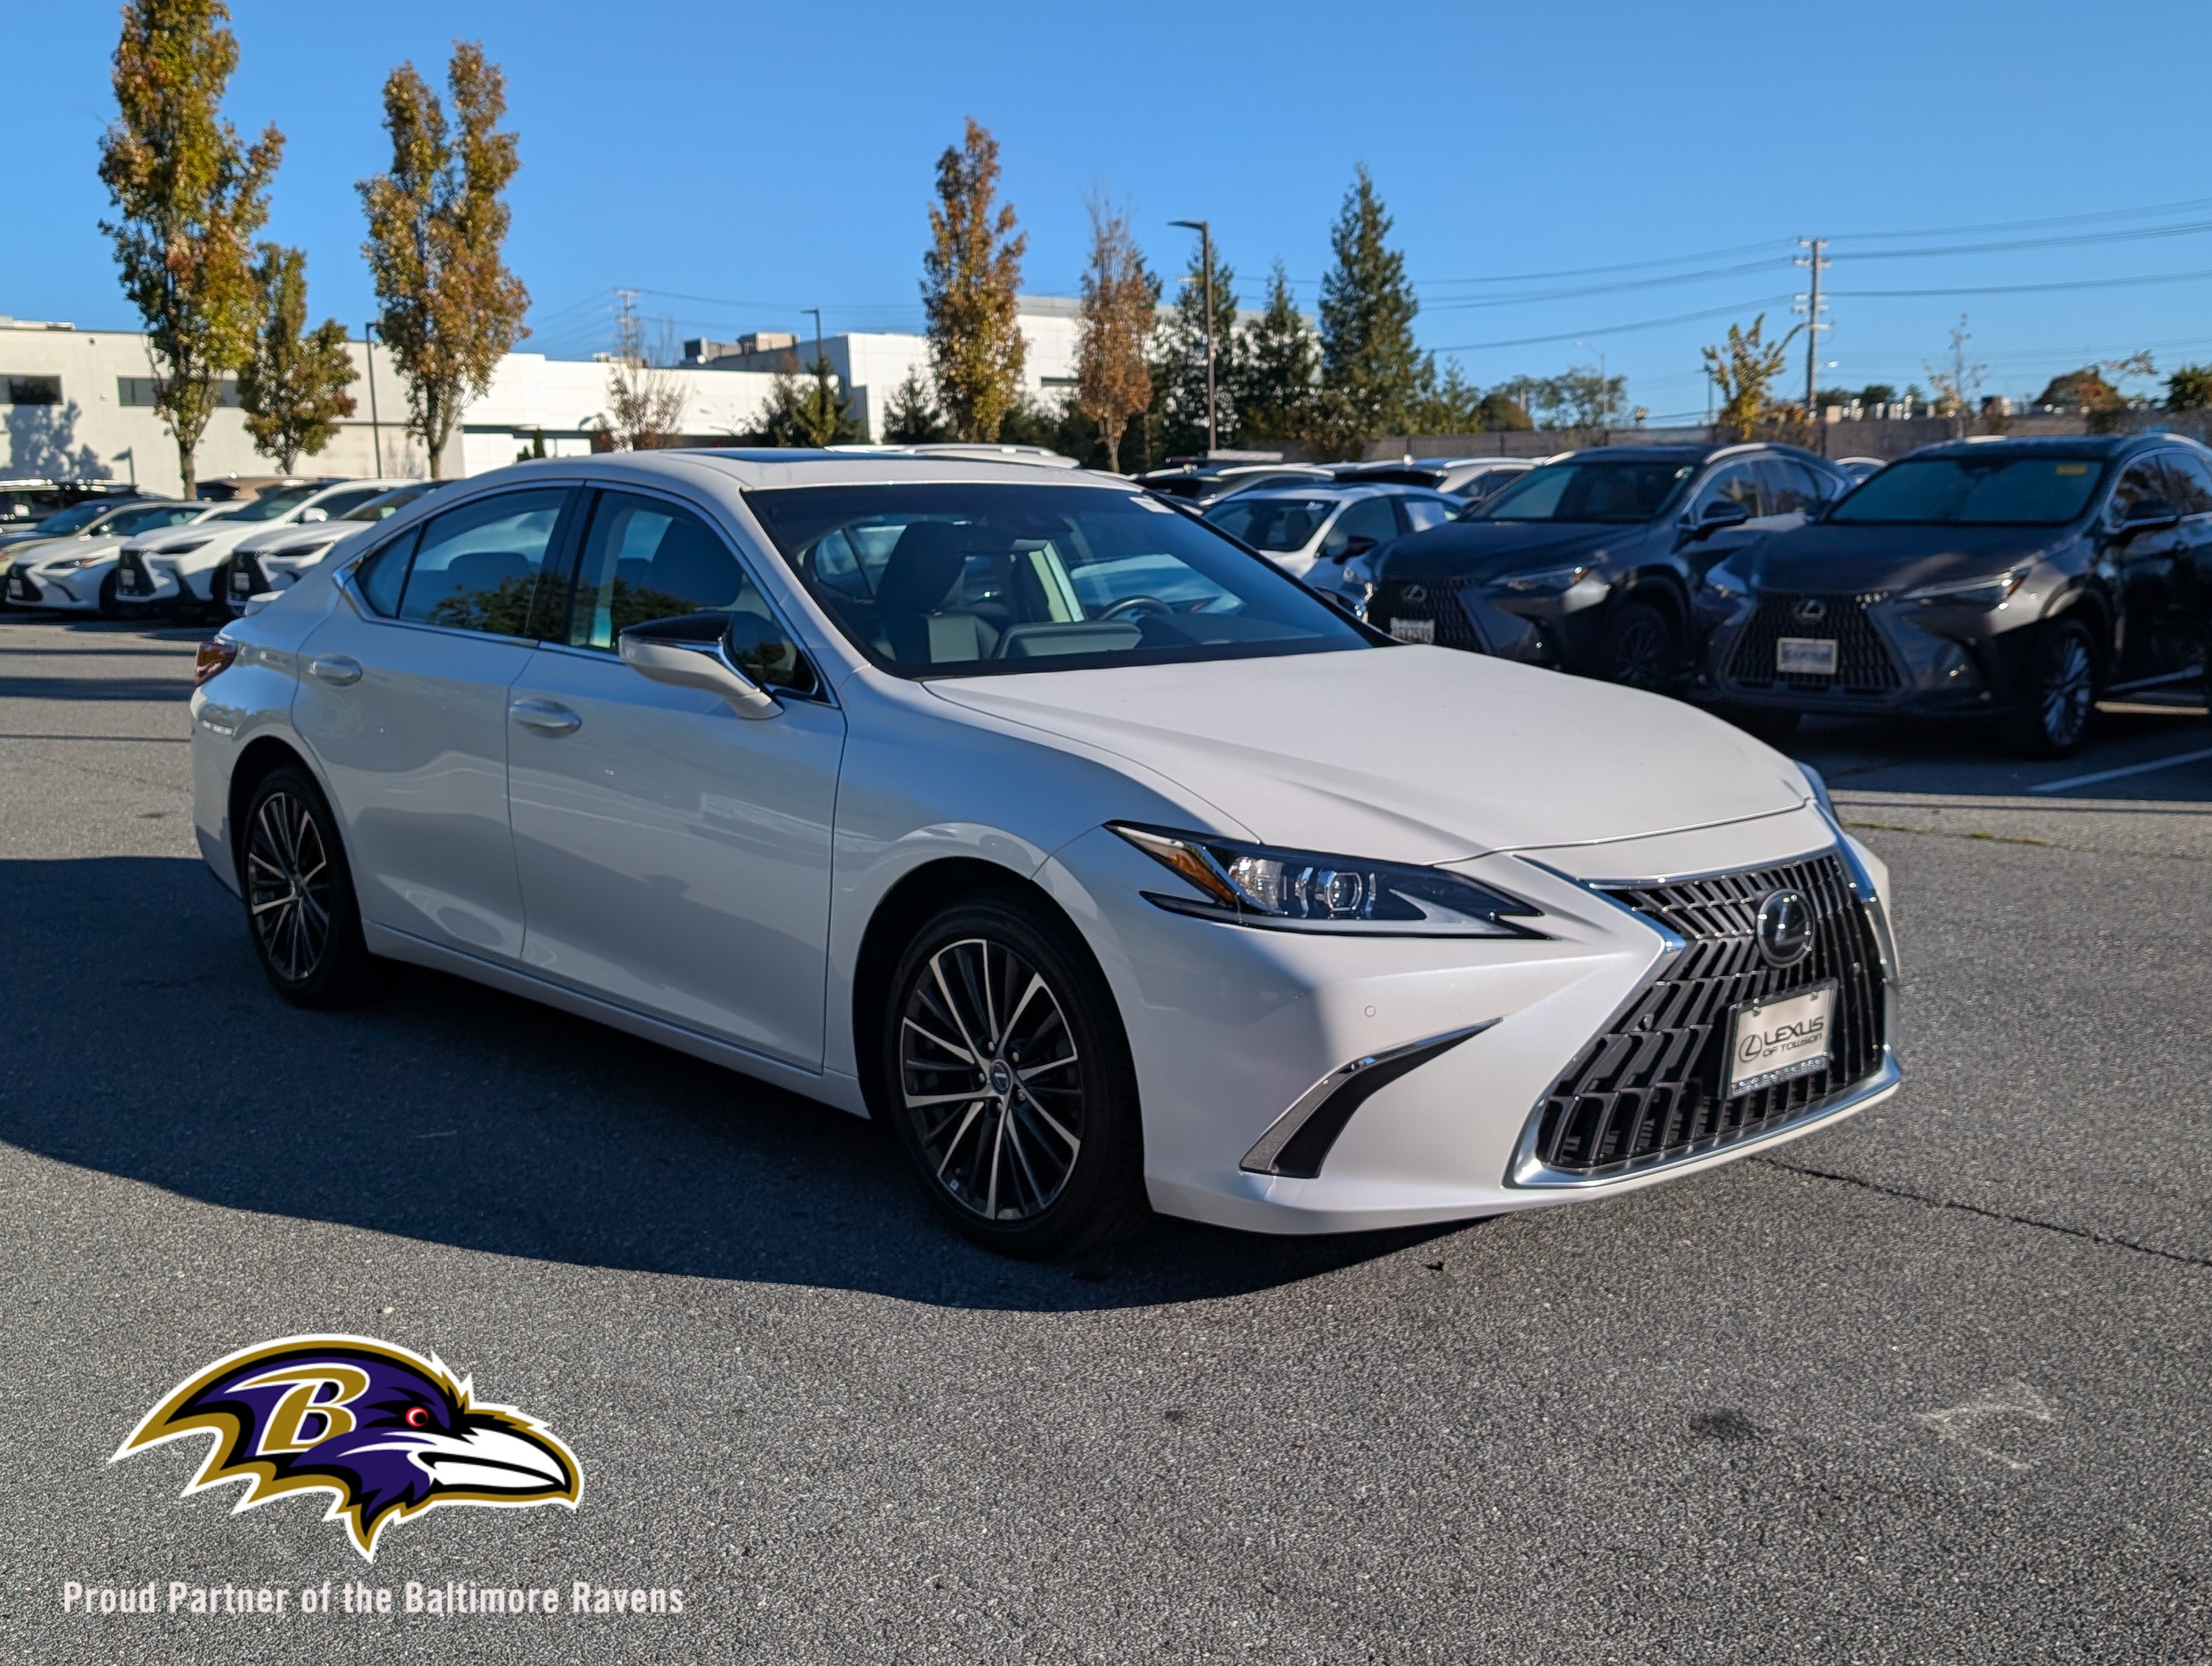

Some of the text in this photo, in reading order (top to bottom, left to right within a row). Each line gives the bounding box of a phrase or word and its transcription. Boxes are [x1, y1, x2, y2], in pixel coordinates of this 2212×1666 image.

[1764, 1015, 1824, 1046] LEXUS
[1763, 1033, 1822, 1058] OF TOWSON
